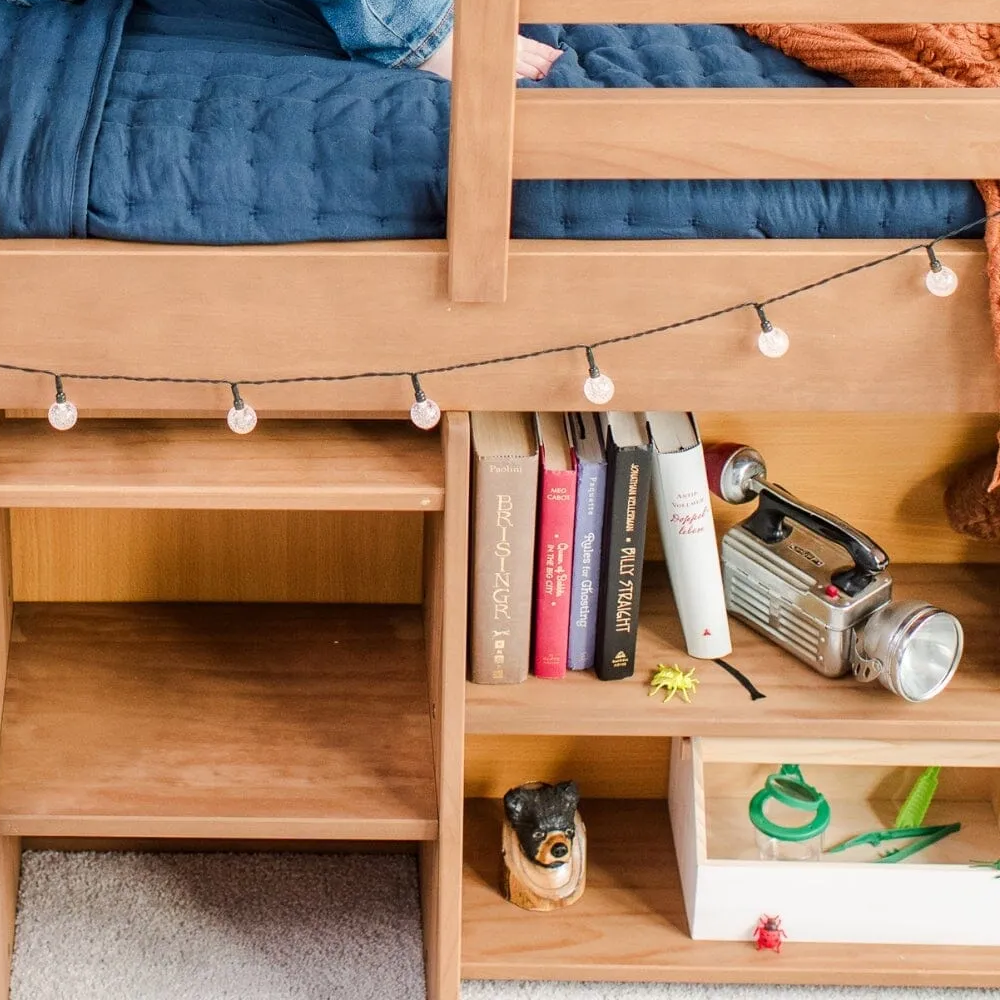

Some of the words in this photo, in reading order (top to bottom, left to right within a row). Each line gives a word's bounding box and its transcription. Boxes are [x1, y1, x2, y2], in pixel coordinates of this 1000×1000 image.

[490, 464, 522, 474] Paolini
[588, 476, 598, 516] Paquette
[494, 494, 514, 620] BRISINGR
[546, 553, 554, 566] THE
[581, 532, 595, 564] Rules
[620, 547, 636, 576] BILLY
[546, 566, 554, 578] BIG
[582, 566, 590, 577] for
[544, 579, 553, 595] CITY
[576, 580, 592, 628] Ghosting
[615, 580, 634, 633] STRAIGHT
